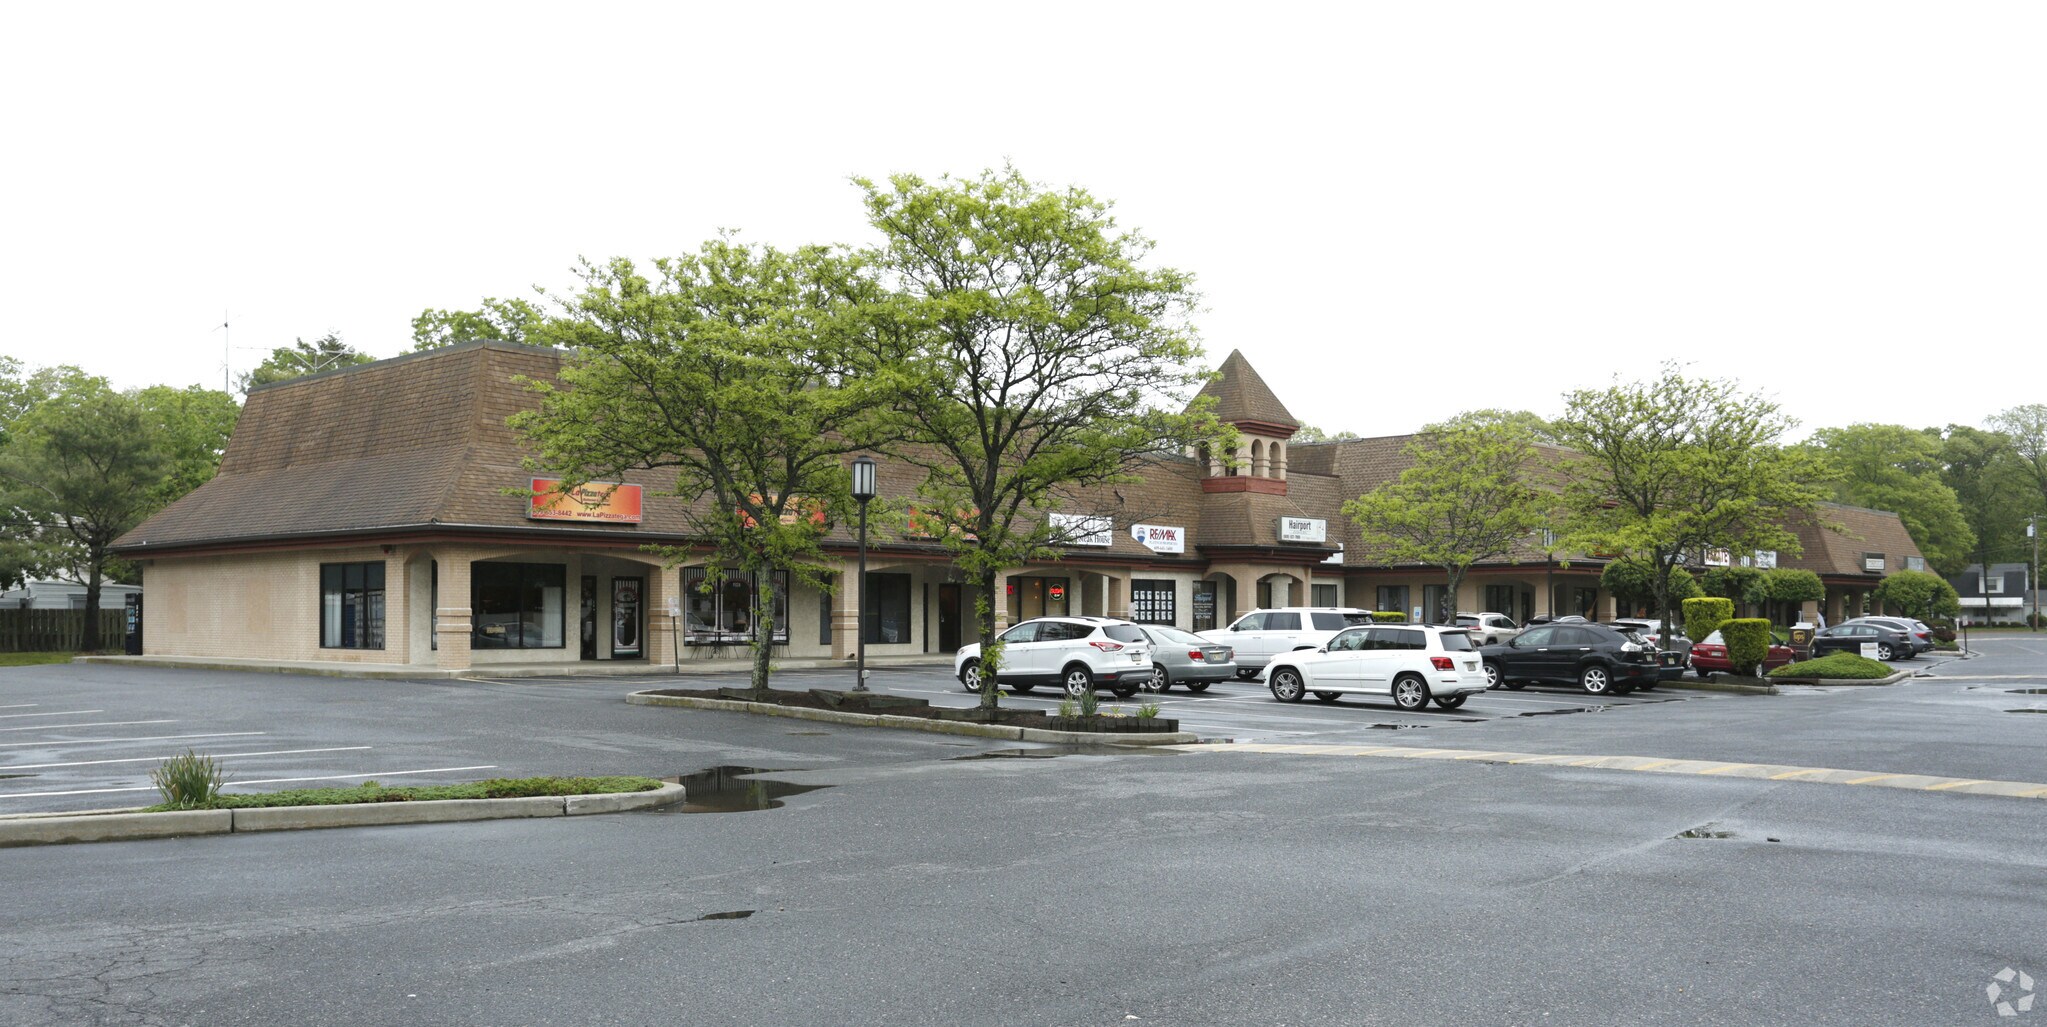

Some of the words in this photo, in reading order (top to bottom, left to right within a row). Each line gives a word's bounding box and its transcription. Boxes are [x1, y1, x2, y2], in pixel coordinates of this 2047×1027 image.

[577, 511, 640, 520] www.LaPizzatega.com
[1289, 520, 1311, 531] Hairport
[1150, 528, 1176, 541] RE/MAX
